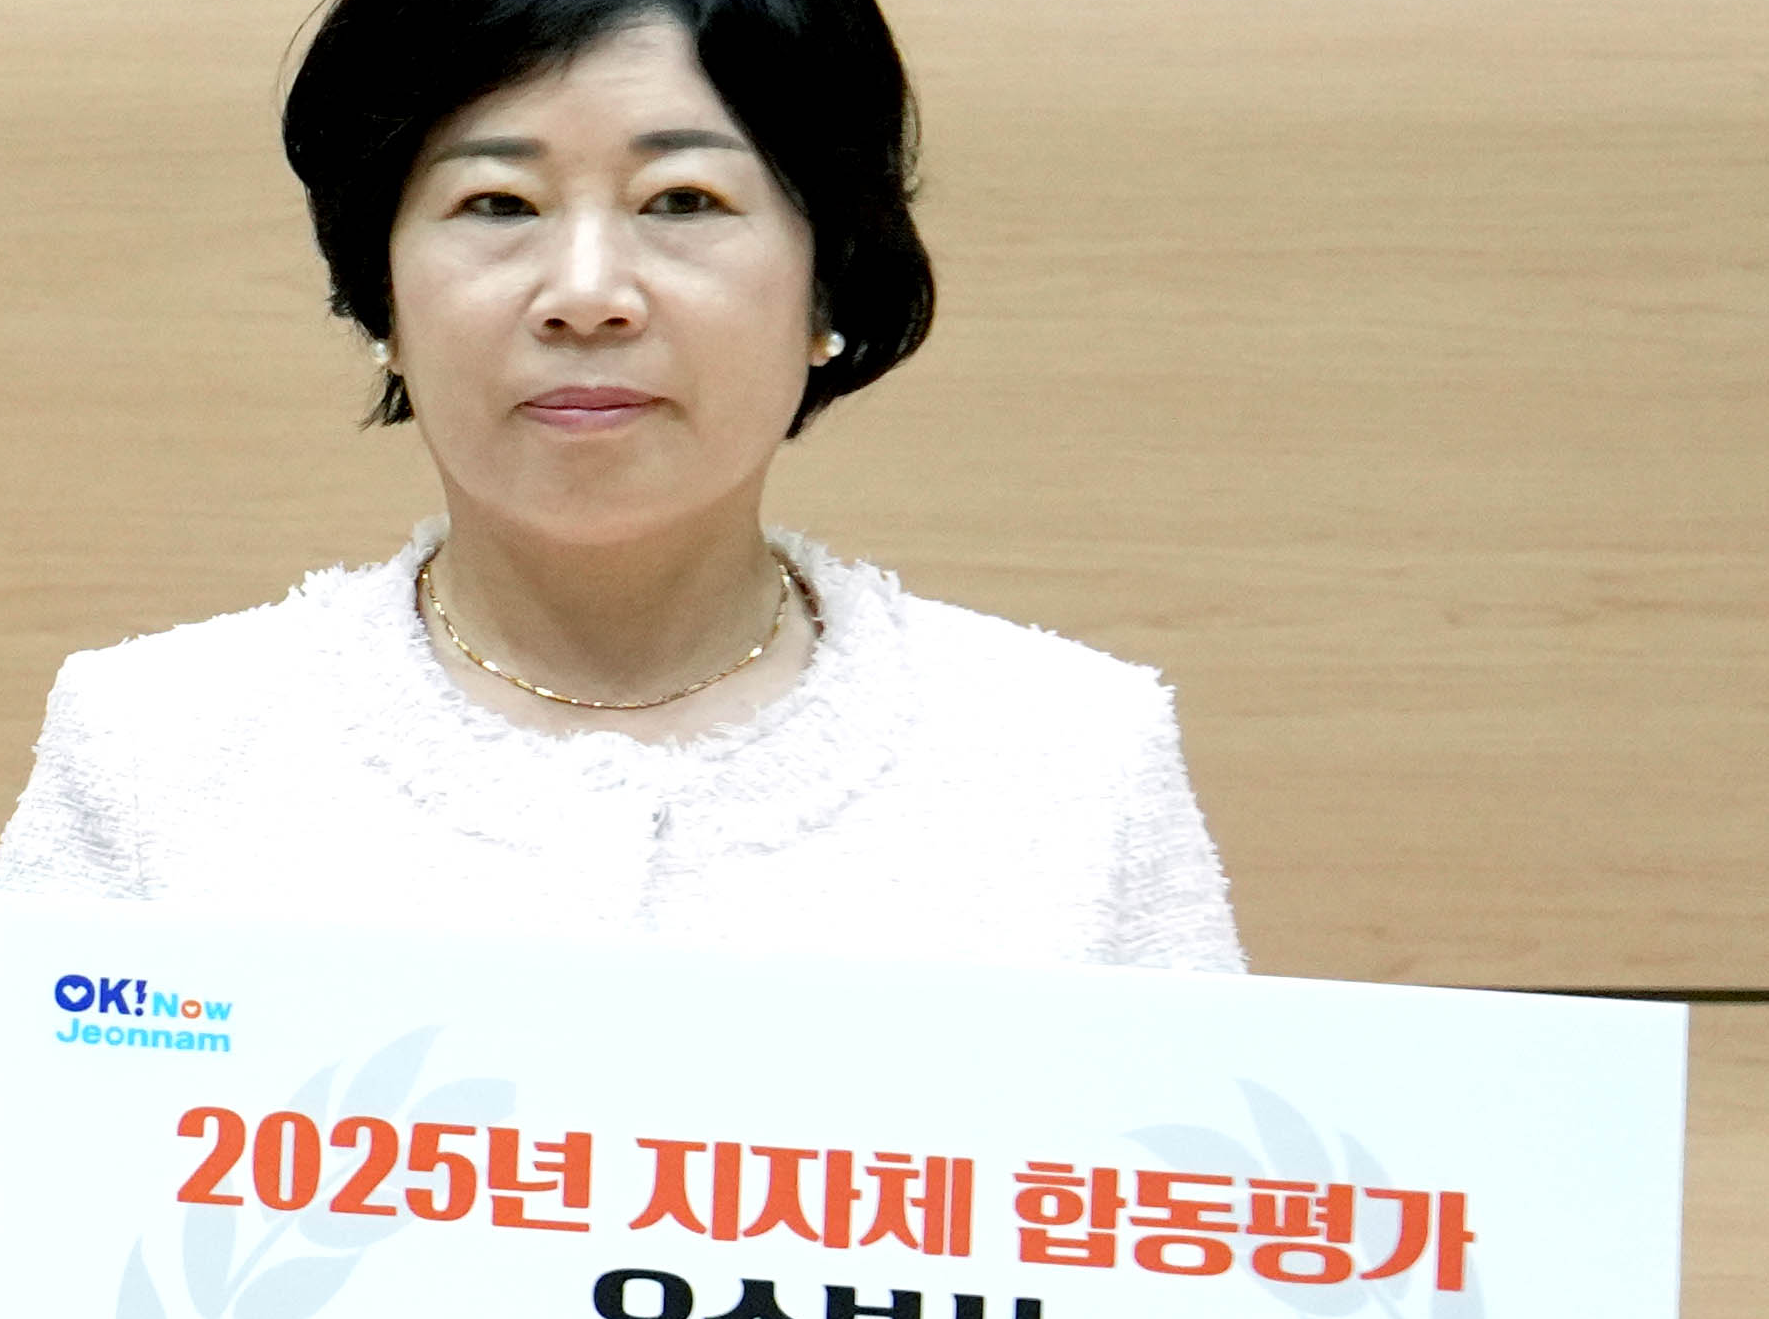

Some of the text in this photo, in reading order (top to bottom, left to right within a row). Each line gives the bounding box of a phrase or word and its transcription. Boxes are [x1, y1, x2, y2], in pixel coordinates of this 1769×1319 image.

[55, 975, 231, 1020] OK! Now
[57, 1019, 230, 1052] Jeonnam
[178, 1107, 1474, 1291] 2025년 지자체 합동평가
